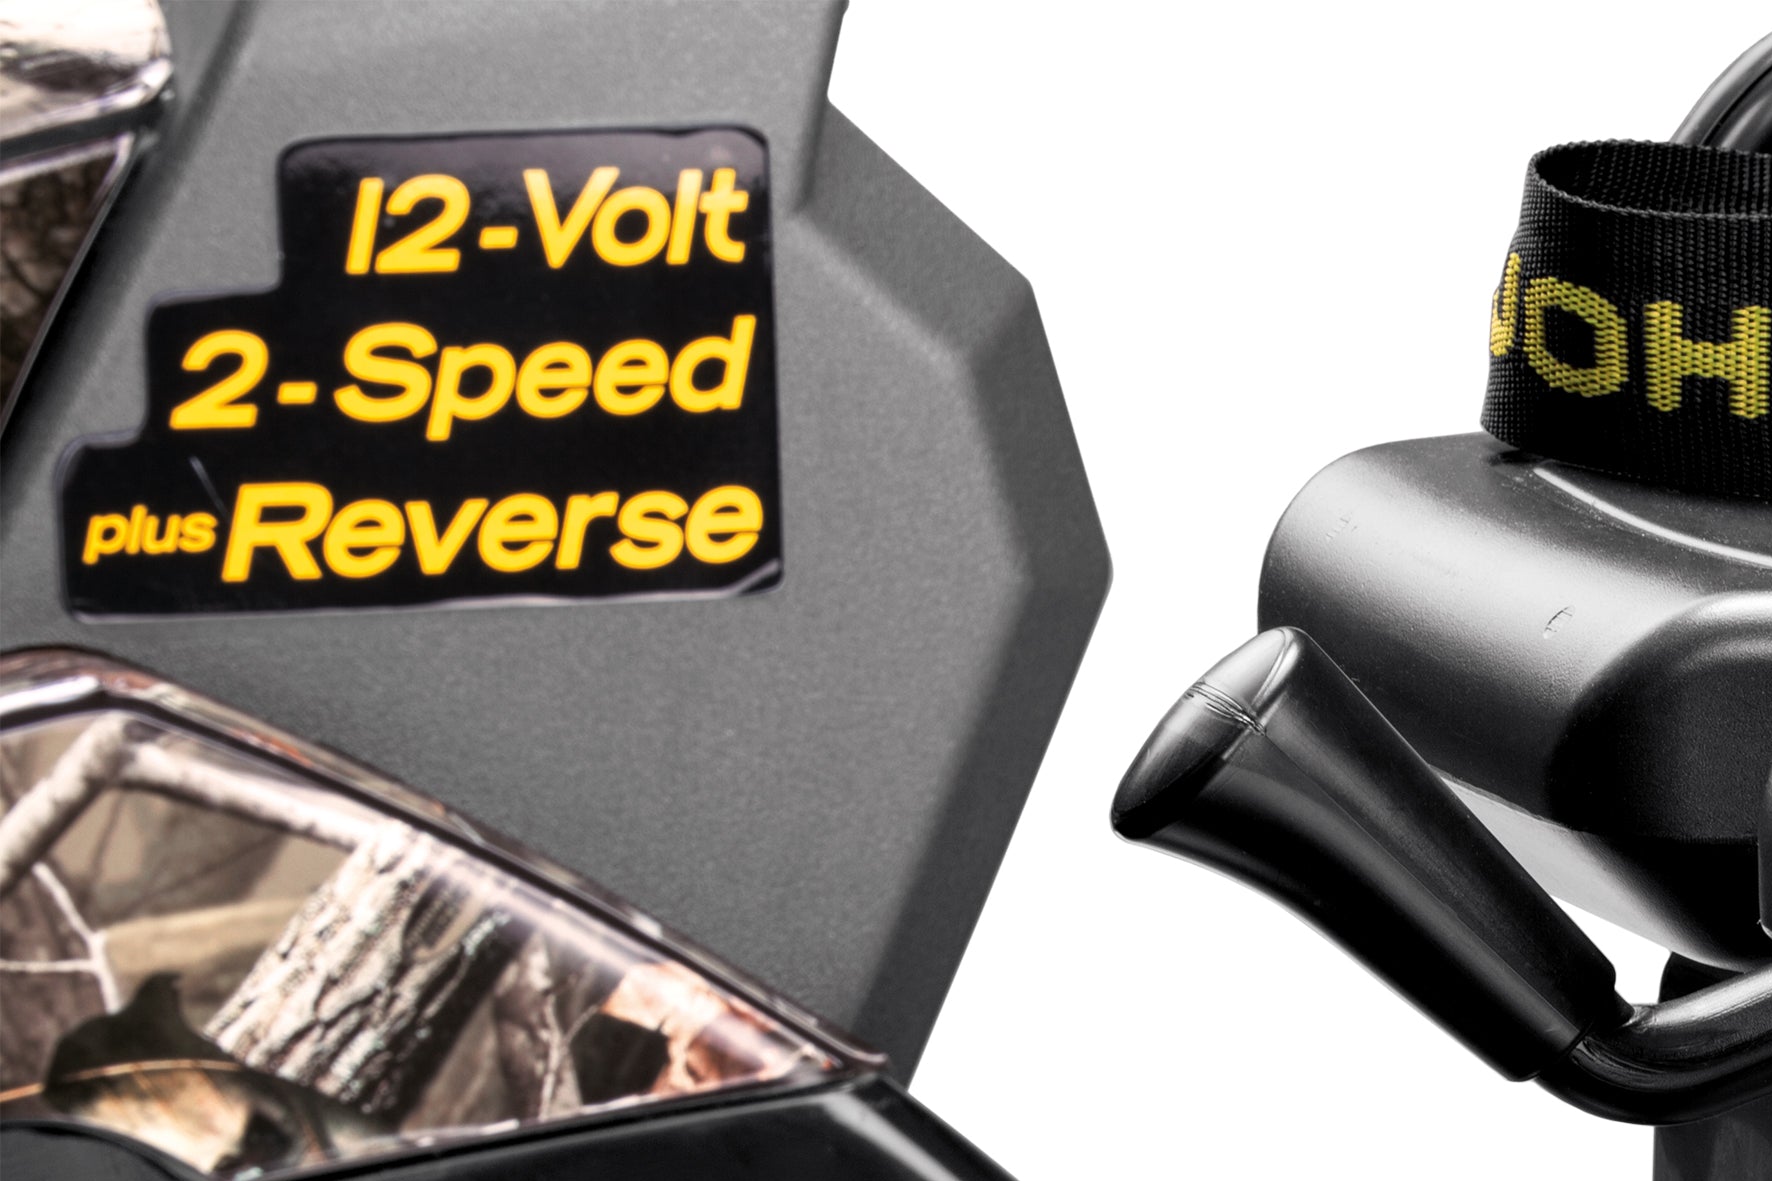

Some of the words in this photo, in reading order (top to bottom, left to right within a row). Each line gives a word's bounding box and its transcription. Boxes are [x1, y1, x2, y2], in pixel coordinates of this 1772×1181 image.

[344, 166, 750, 276] 12-Volt
[168, 313, 758, 443] 2-Speed
[81, 503, 218, 566] plus
[220, 483, 765, 584] Reverse
